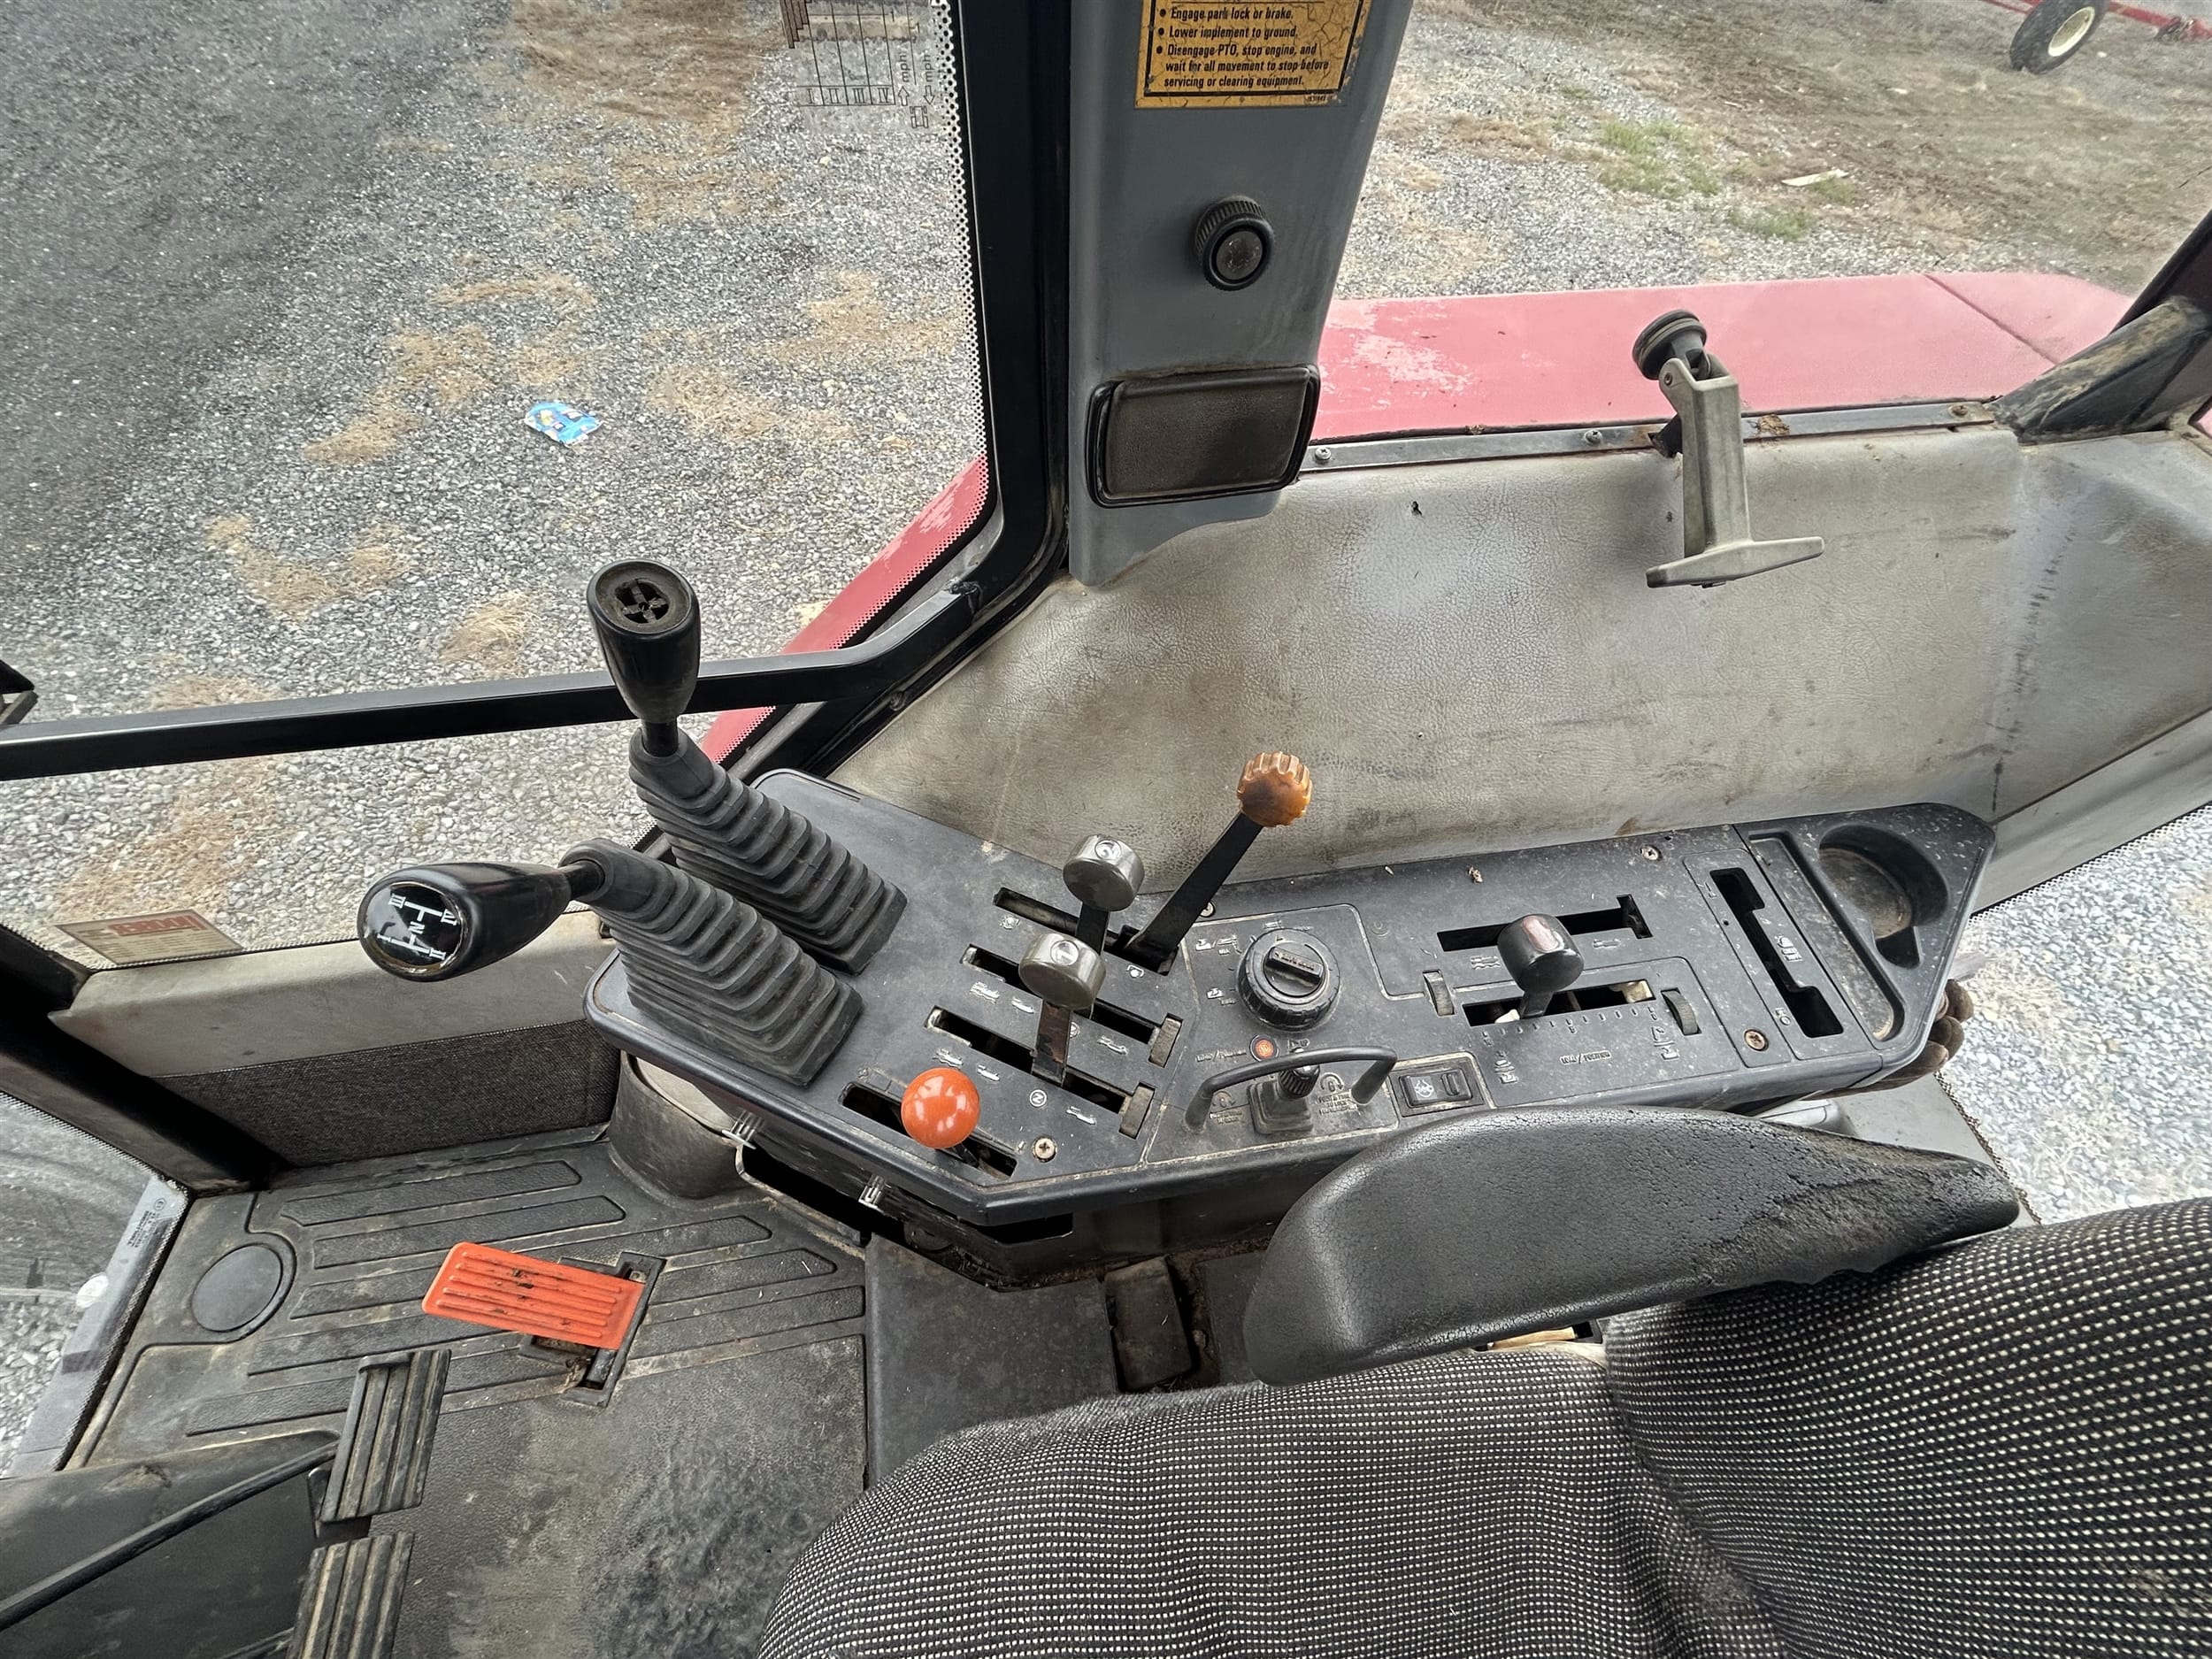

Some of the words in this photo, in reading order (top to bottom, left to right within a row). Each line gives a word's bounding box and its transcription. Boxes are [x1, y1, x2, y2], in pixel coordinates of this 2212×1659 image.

[1171, 8, 1205, 21] Engage
[1207, 8, 1228, 22] park
[1230, 7, 1250, 19] lock
[1253, 10, 1263, 19] or
[1265, 7, 1294, 19] brake.
[1169, 27, 1198, 38] Lower
[1201, 26, 1248, 40] implement
[1251, 27, 1263, 38] to
[1264, 27, 1298, 39] ground.
[1167, 44, 1215, 58] Disengage
[1217, 44, 1239, 58] PTO,
[1242, 44, 1263, 58] stop
[1265, 44, 1297, 58] engine,
[1300, 43, 1317, 56] and
[898, 52, 911, 83] mph
[922, 53, 935, 83] mph
[1165, 61, 1186, 73] wait
[1189, 61, 1202, 73] for
[1203, 61, 1215, 73] all
[1217, 61, 1264, 72] movement
[1267, 61, 1276, 72] to
[1279, 62, 1298, 73] stop
[1301, 60, 1329, 71] before
[1164, 76, 1204, 88] servicing
[1207, 78, 1217, 87] or
[1218, 75, 1255, 88] clearing
[1256, 75, 1305, 88] equipment.
[807, 88, 816, 104] I
[827, 88, 841, 104] II
[852, 88, 867, 104] III
[877, 87, 889, 104] IV
[1100, 842, 1118, 859] 2
[388, 894, 406, 909] III
[441, 909, 457, 926] IV
[408, 921, 426, 934] N
[429, 948, 447, 960] II
